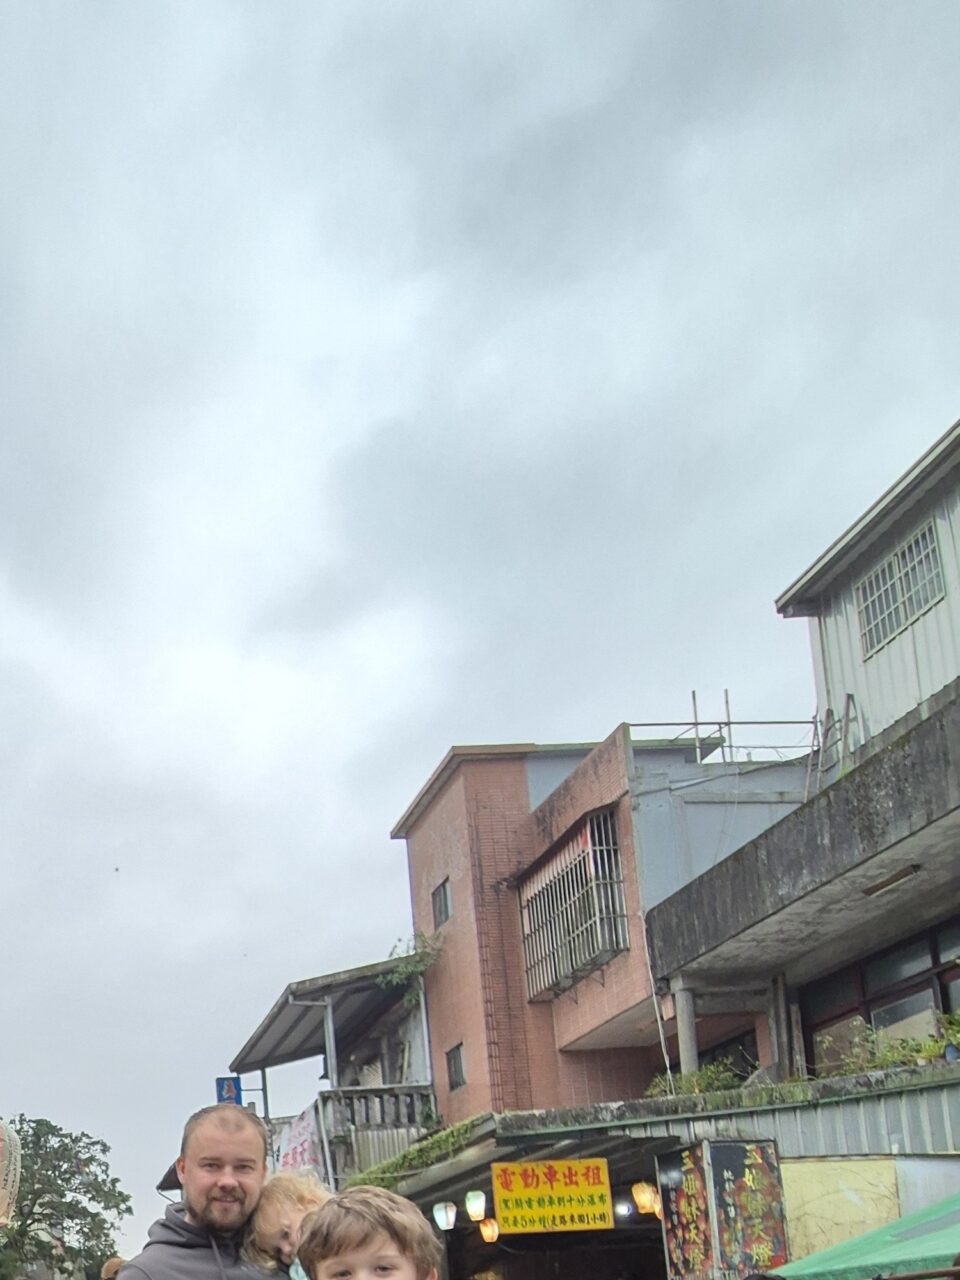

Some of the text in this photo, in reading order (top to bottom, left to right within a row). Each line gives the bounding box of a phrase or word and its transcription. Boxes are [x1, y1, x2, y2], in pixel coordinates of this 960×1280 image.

[496, 1163, 605, 1193] 電動車出租
